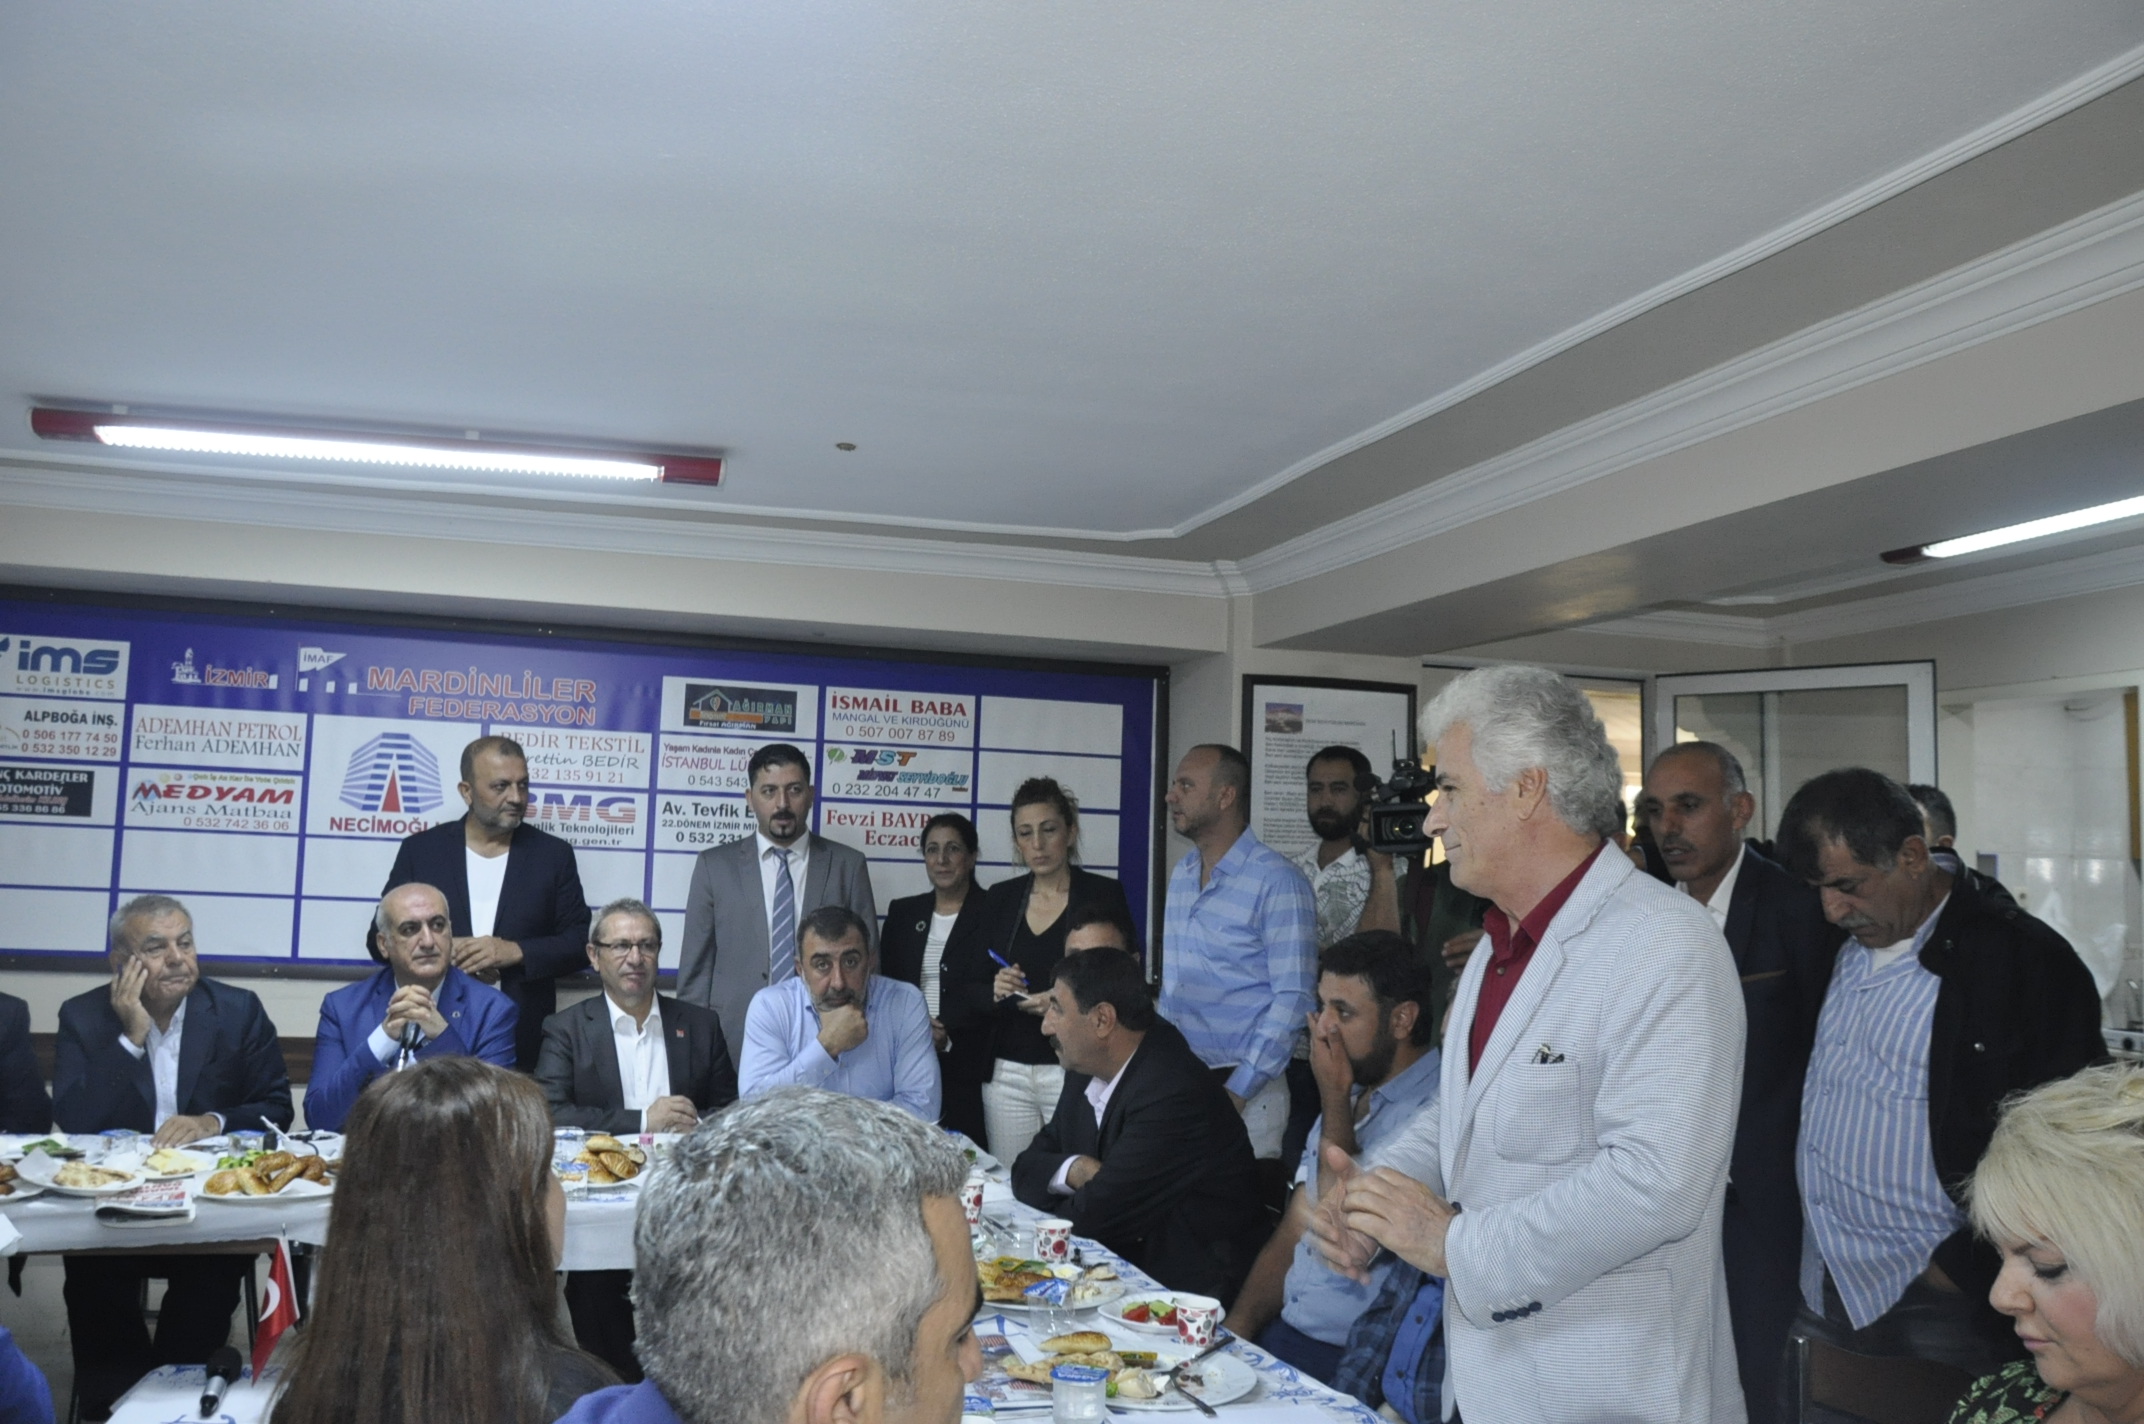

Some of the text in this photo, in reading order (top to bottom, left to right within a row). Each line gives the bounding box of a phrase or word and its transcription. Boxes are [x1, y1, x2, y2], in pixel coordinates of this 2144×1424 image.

[18, 639, 120, 675] ims
[303, 651, 334, 663] İMAF
[16, 675, 115, 690] LOGISTICS
[205, 664, 270, 688] İZMİR
[368, 666, 597, 703] MARDİNLİLER
[408, 696, 597, 726] FEDERASYON
[831, 691, 967, 717] İSMAİL BABA
[24, 708, 88, 725] ALPBOĞA
[832, 712, 879, 724] MANGAL
[884, 714, 898, 725] VE
[22, 729, 118, 744] 0 506 177 74 50
[135, 716, 302, 742] ADEMHAN PETROL
[846, 725, 955, 742] 0 507 007 87 89
[21, 742, 29, 753] 0
[33, 744, 55, 754] 532
[59, 745, 80, 755] 350
[85, 747, 99, 757] 12
[102, 747, 117, 757] 29
[135, 735, 300, 758] Ferhan ADEMHAN
[565, 734, 645, 754] TEKSTİL
[526, 752, 640, 770] rettin BEDİR
[661, 752, 750, 772] İSTANBUL LÜ
[851, 749, 918, 767] MST
[530, 767, 625, 784] 32 135 91 21
[687, 775, 748, 788] 0 543 543
[132, 782, 294, 804] MEDYAM
[832, 783, 841, 795] 0
[845, 783, 870, 796] 232
[874, 785, 899, 797] 204
[904, 786, 920, 798] 47
[924, 787, 941, 799] 47
[130, 801, 292, 820] Ajans Matbaa
[662, 801, 686, 816] Av.
[692, 802, 739, 818] Tevfik
[183, 816, 289, 831] 0 532 742 36 06
[329, 815, 440, 835] NECİMOĞL
[714, 820, 741, 831] İZMİR
[826, 809, 932, 829] Fevzi BAYR
[534, 822, 635, 837] nlik Teknolojileri
[676, 831, 685, 843] 0
[689, 832, 715, 844] 532
[566, 837, 622, 847] g.gen.tr
[864, 829, 922, 848] Eczac
